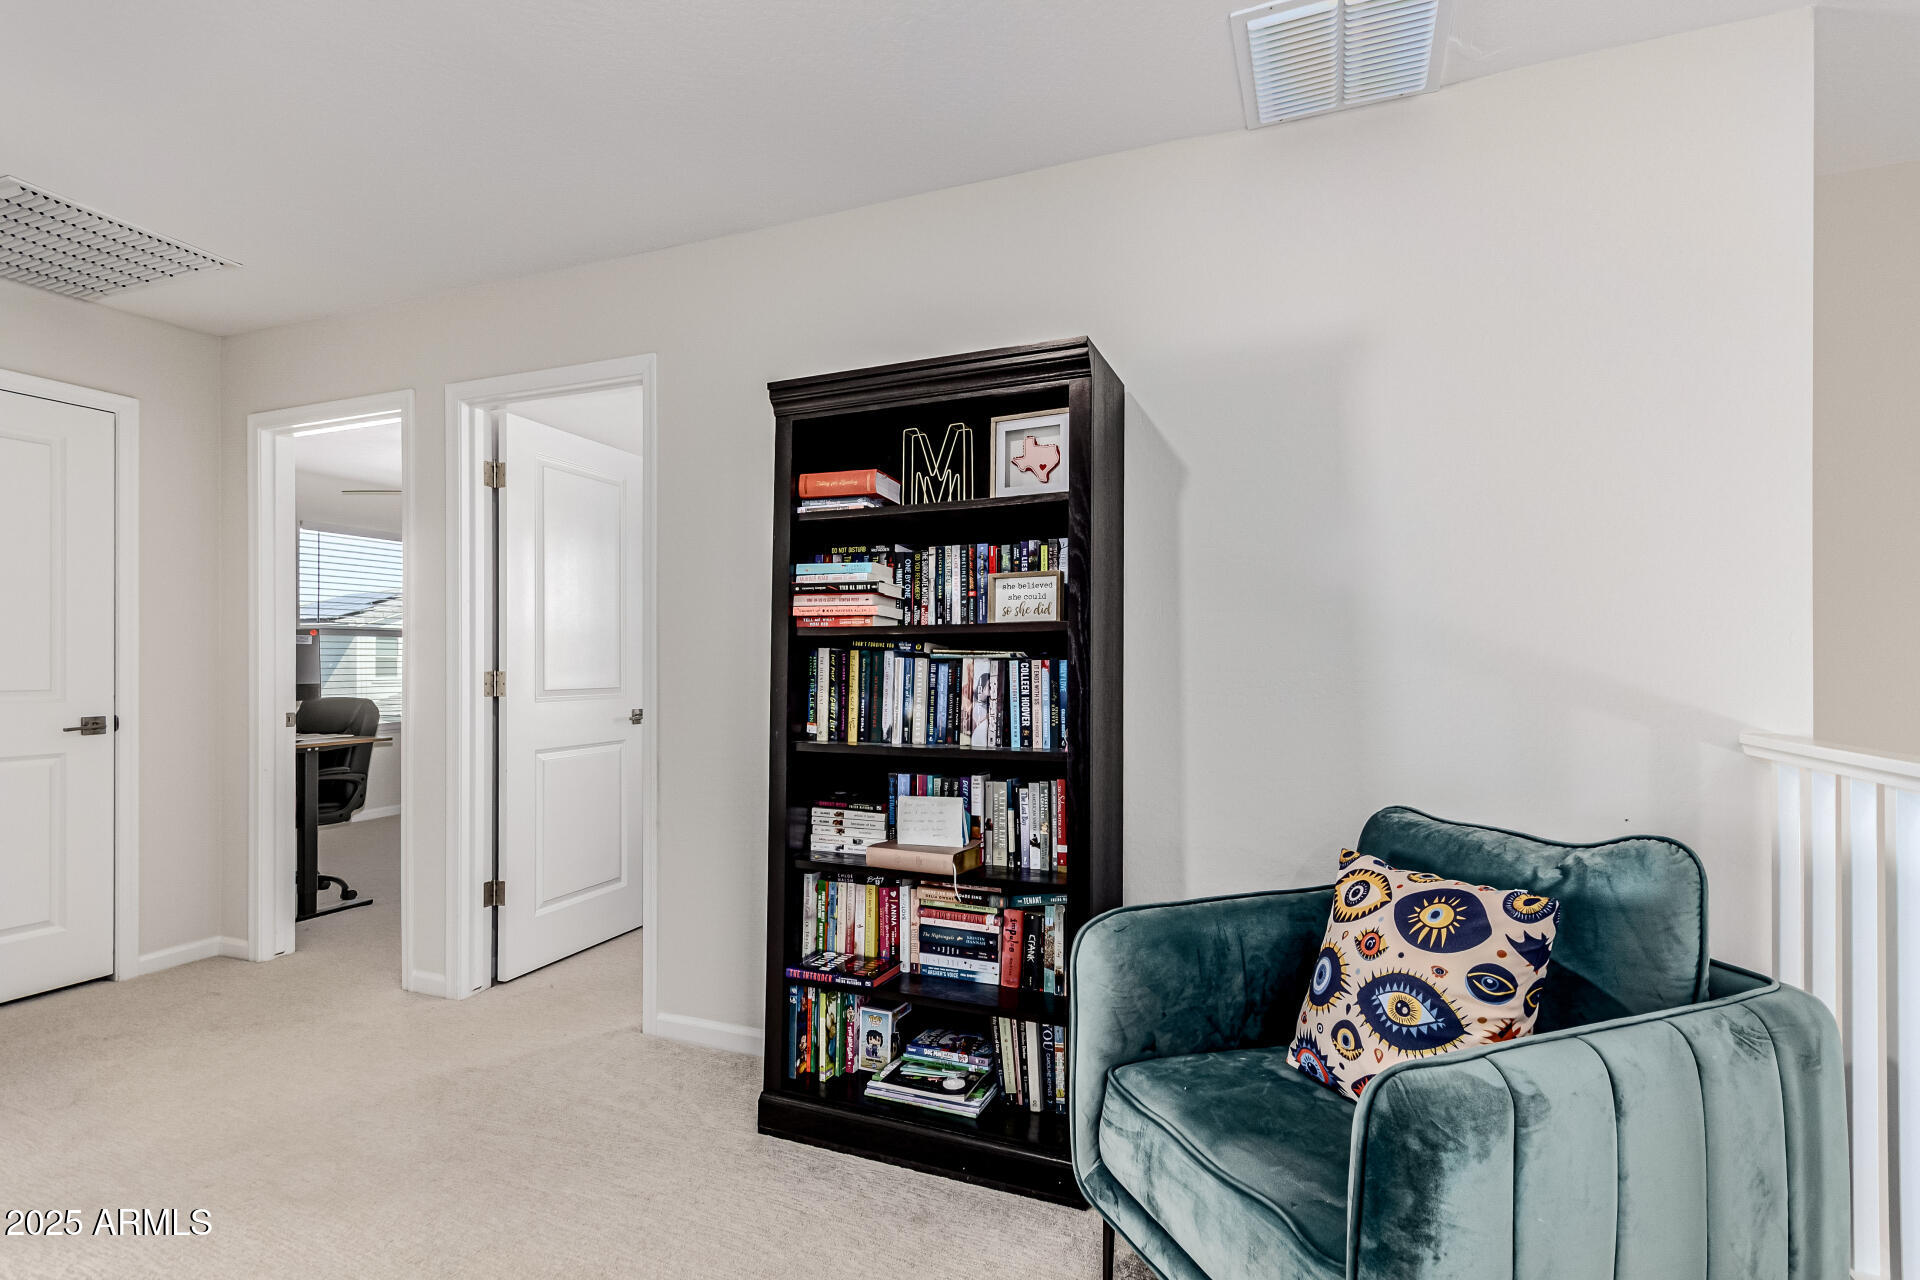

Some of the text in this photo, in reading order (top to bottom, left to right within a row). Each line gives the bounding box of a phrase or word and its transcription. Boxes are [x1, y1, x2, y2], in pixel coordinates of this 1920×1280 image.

[905, 574, 911, 583] BY
[1002, 601, 1052, 616] so she did
[1021, 663, 1030, 726] COLLEEN HOOVER
[1023, 896, 1042, 904] TENANT
[1027, 934, 1036, 963] CRANK
[802, 971, 832, 982] INTRUDER
[1042, 1024, 1053, 1052] YOU
